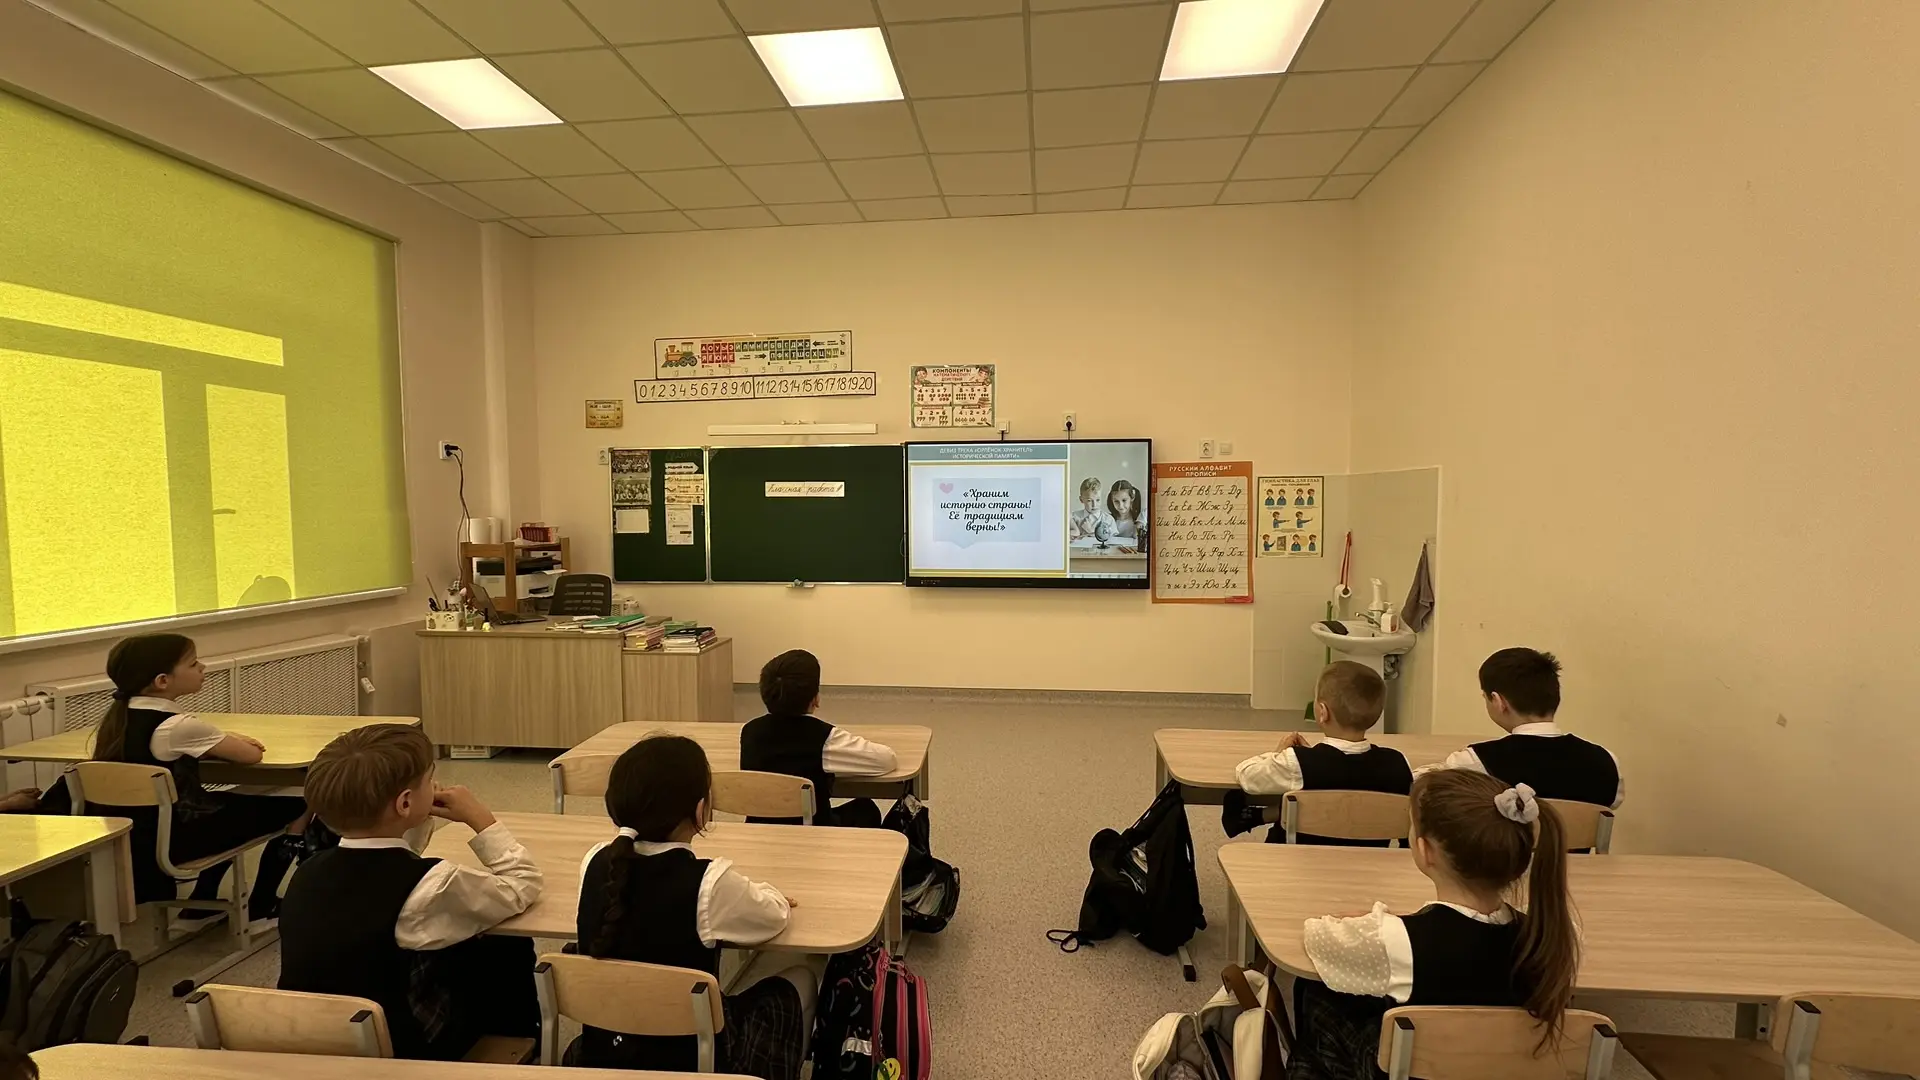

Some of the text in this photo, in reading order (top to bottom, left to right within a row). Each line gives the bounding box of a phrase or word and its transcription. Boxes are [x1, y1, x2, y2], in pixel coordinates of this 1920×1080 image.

[640, 377, 873, 398] 0 1 2 3 4 5 6 7 8 9 10 11 12 13 14 15 16 17 18 19 20
[963, 489, 1009, 501] «Храним
[940, 500, 1032, 512] историю страны!
[949, 511, 1024, 523] Её традициям
[966, 521, 1006, 534] верны!»
